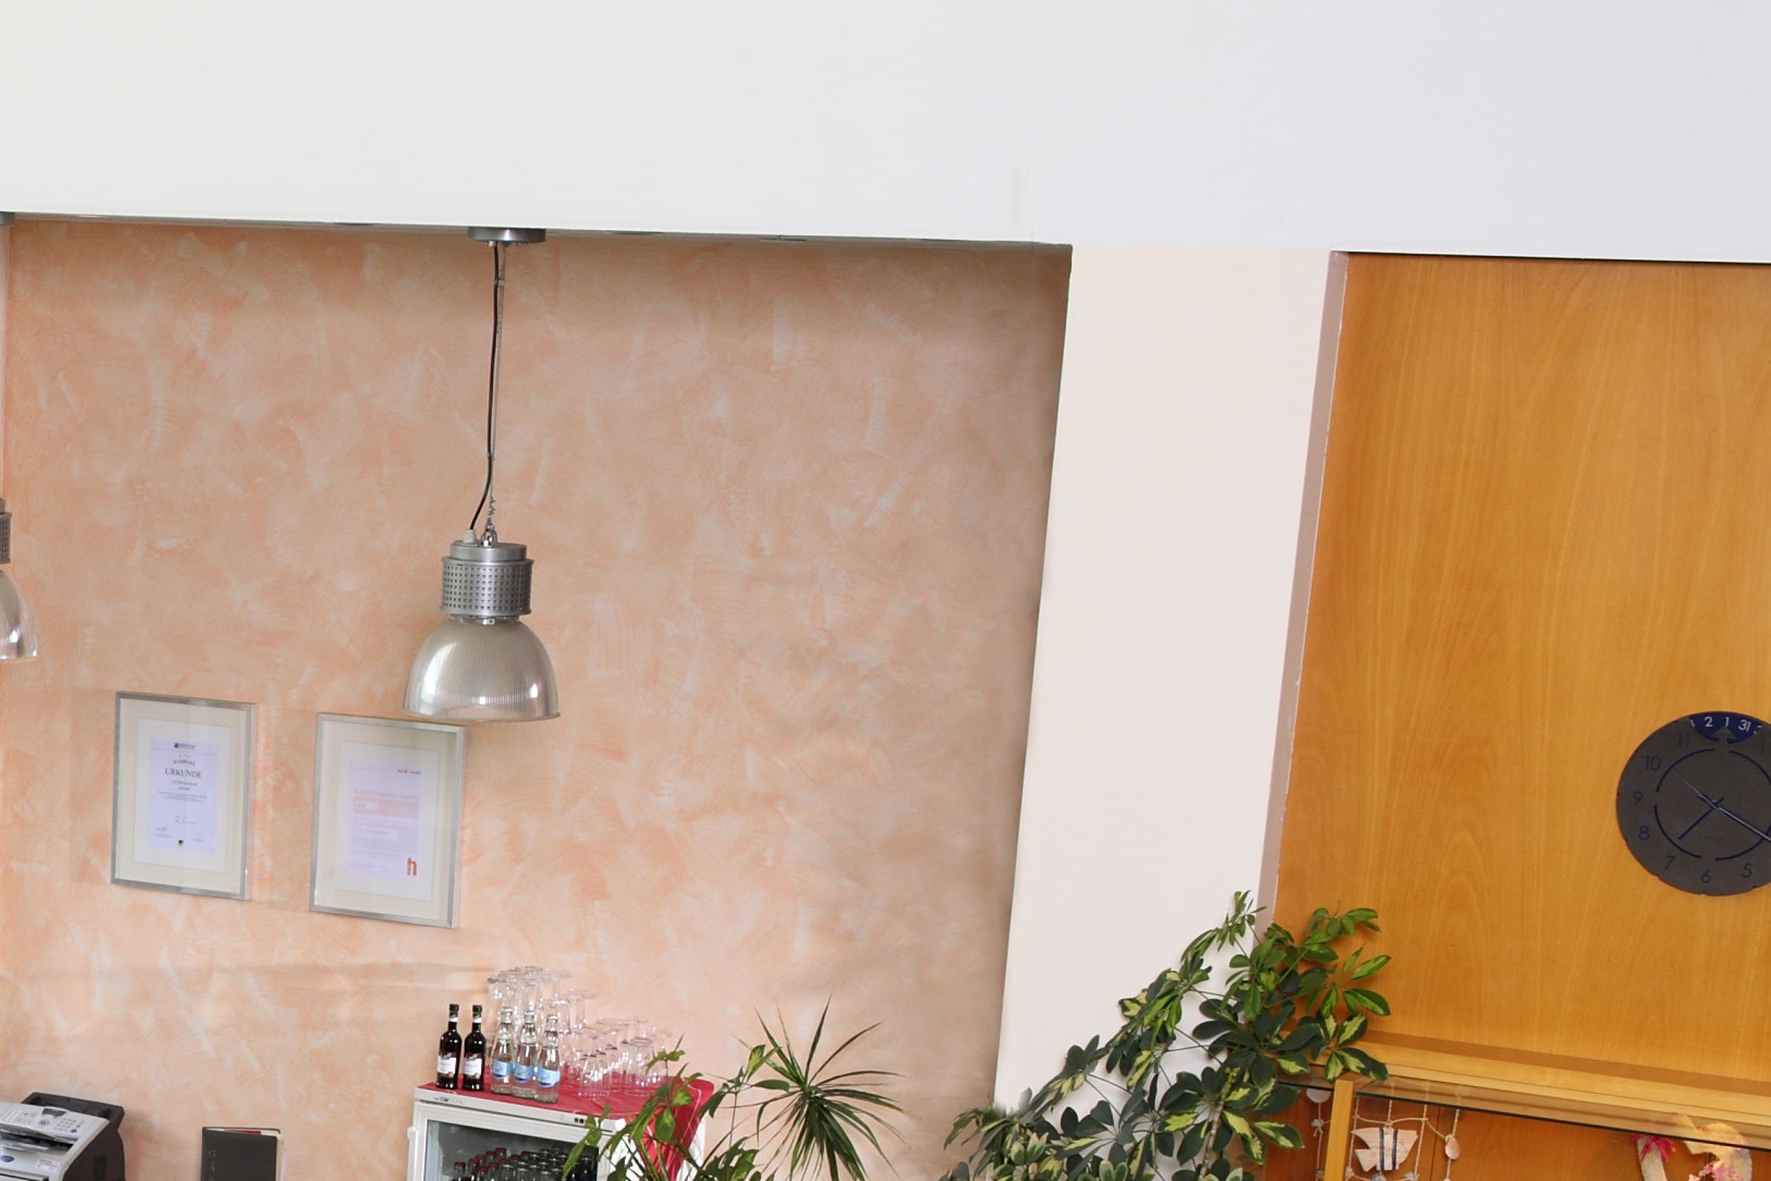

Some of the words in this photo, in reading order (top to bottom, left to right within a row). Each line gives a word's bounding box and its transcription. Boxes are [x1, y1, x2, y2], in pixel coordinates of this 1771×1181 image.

[1704, 716, 1713, 728] 2
[1725, 716, 1730, 727] 1
[1738, 719, 1752, 732] 31
[1644, 754, 1662, 771] 10
[164, 768, 203, 779] URKUNDE
[1632, 791, 1644, 805] 9
[1638, 825, 1650, 841] 8
[1664, 855, 1676, 870] 7
[1701, 869, 1712, 884] 6
[1741, 863, 1753, 878] 5
